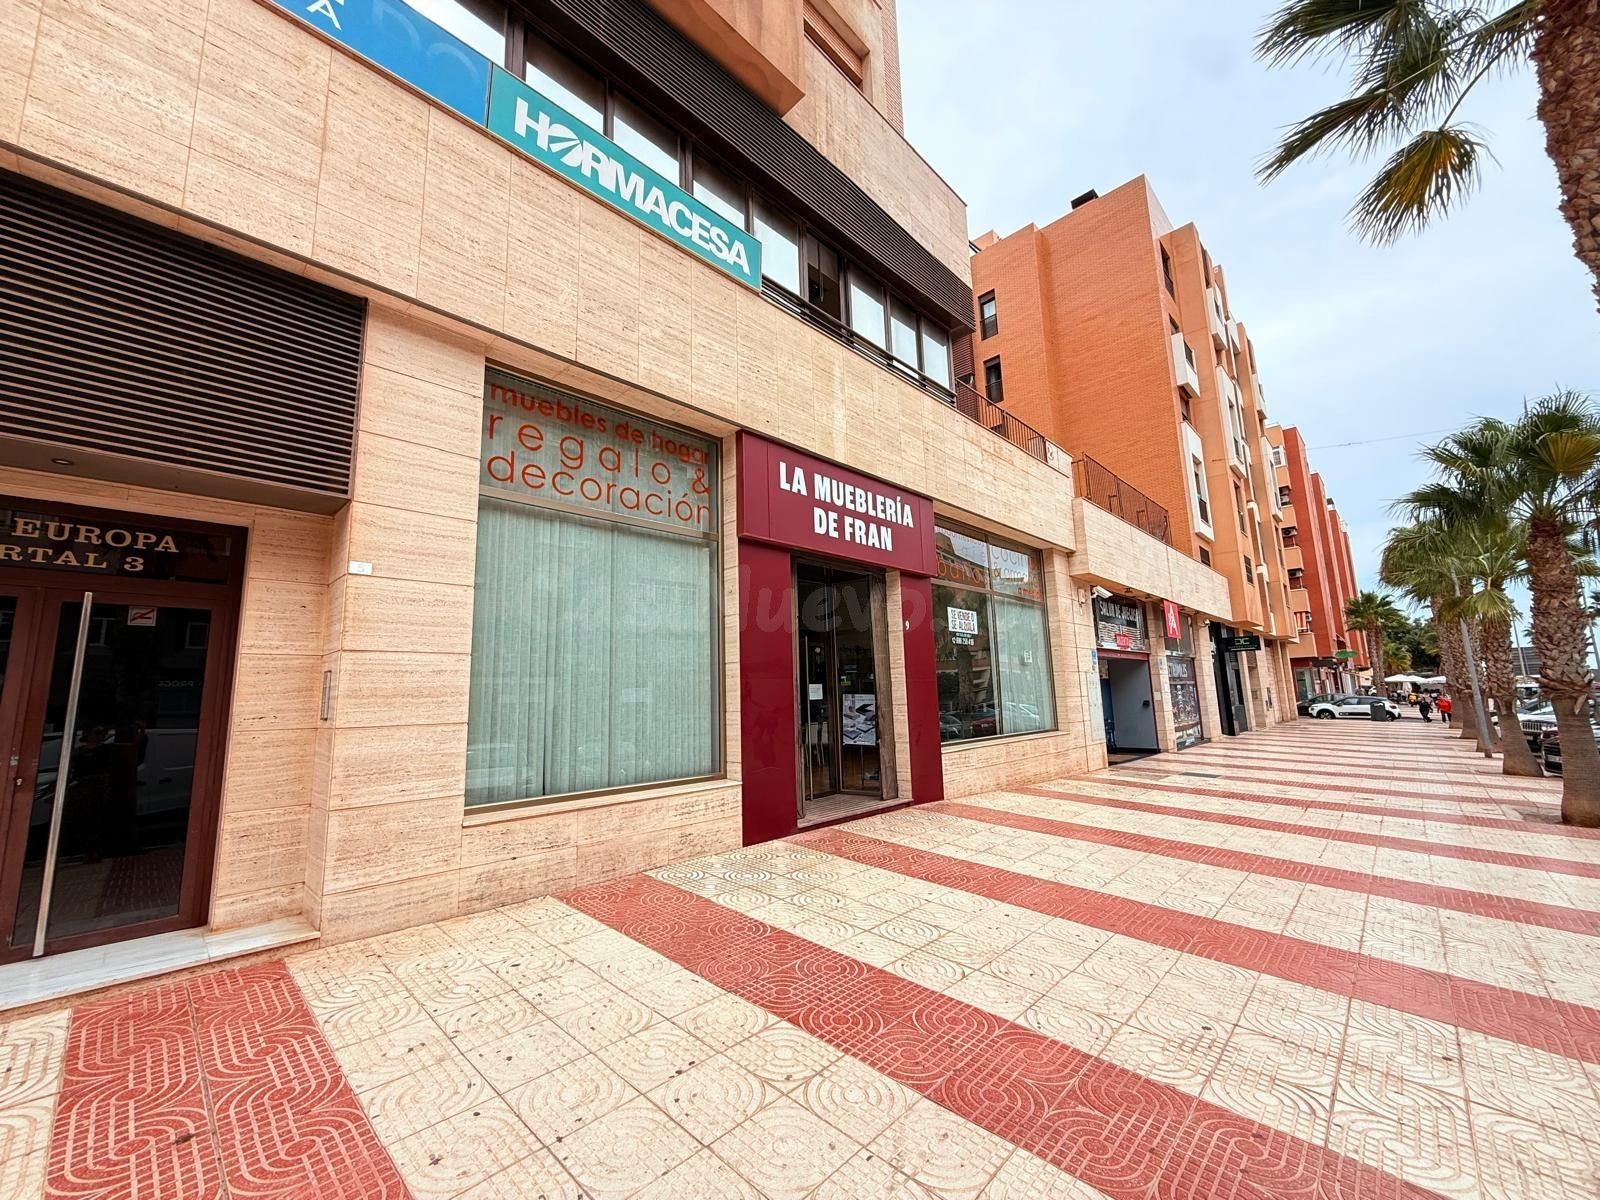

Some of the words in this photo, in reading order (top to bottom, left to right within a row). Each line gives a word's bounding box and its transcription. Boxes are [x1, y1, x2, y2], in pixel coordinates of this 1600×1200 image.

[513, 96, 751, 276] HORMACESA
[490, 383, 606, 434] muebles
[614, 421, 645, 445] de
[486, 451, 711, 525] decoración
[691, 467, 711, 496] &
[779, 461, 807, 496] LA
[813, 473, 914, 528] MUEBLERÍA
[11, 517, 179, 553] EUROPA
[813, 507, 839, 539] DE
[844, 515, 893, 551] FRAN
[123, 556, 144, 572] 3
[905, 620, 910, 631] 9
[951, 610, 957, 619] SE
[957, 611, 970, 621] VENDE
[951, 620, 957, 630] SE
[959, 621, 976, 633] ALQUILA
